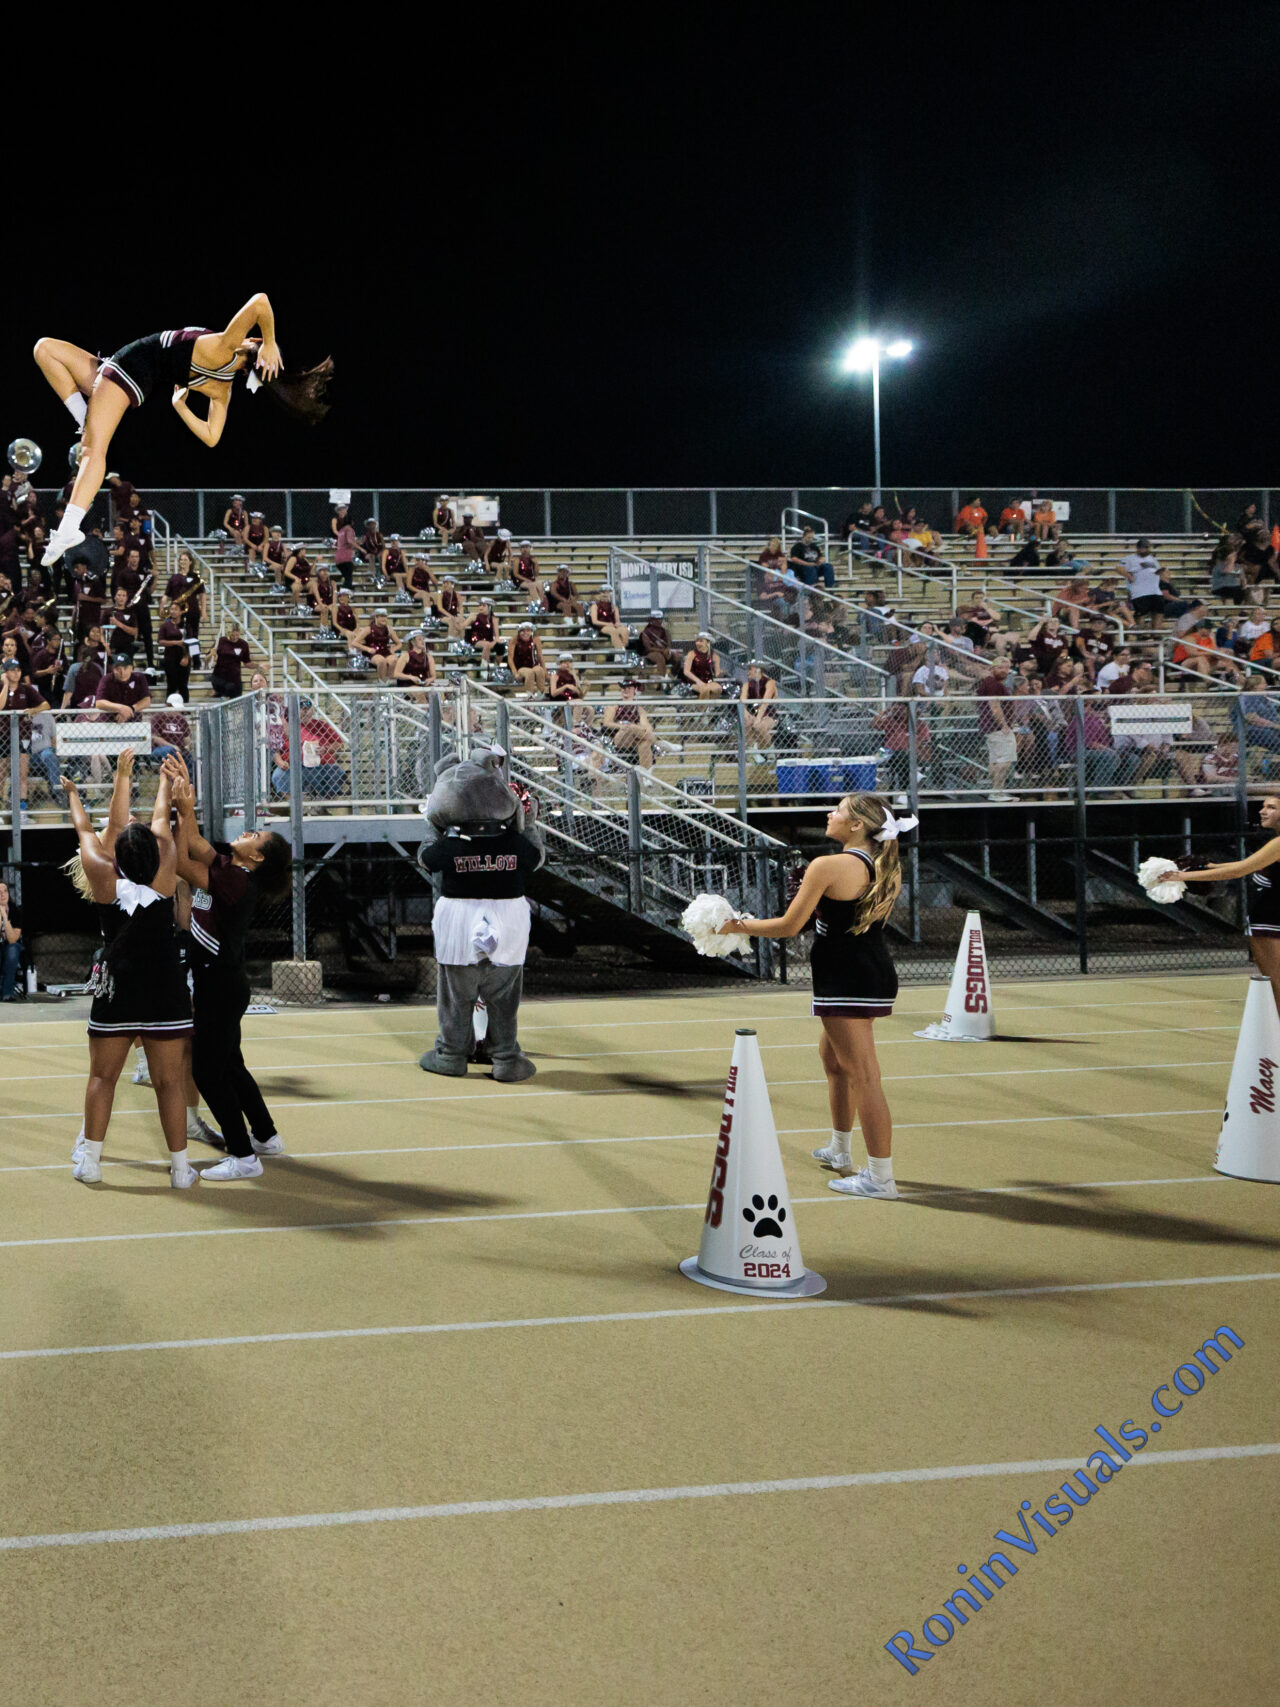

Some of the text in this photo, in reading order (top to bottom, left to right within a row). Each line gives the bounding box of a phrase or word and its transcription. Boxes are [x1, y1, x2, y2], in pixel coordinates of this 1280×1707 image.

[679, 561, 694, 579] ISD
[454, 854, 517, 873] WILLOW
[964, 929, 989, 1015] BULLDOGS
[1249, 1057, 1279, 1115] Macy
[739, 1244, 792, 1262] Class of
[743, 1262, 791, 1278] 2024
